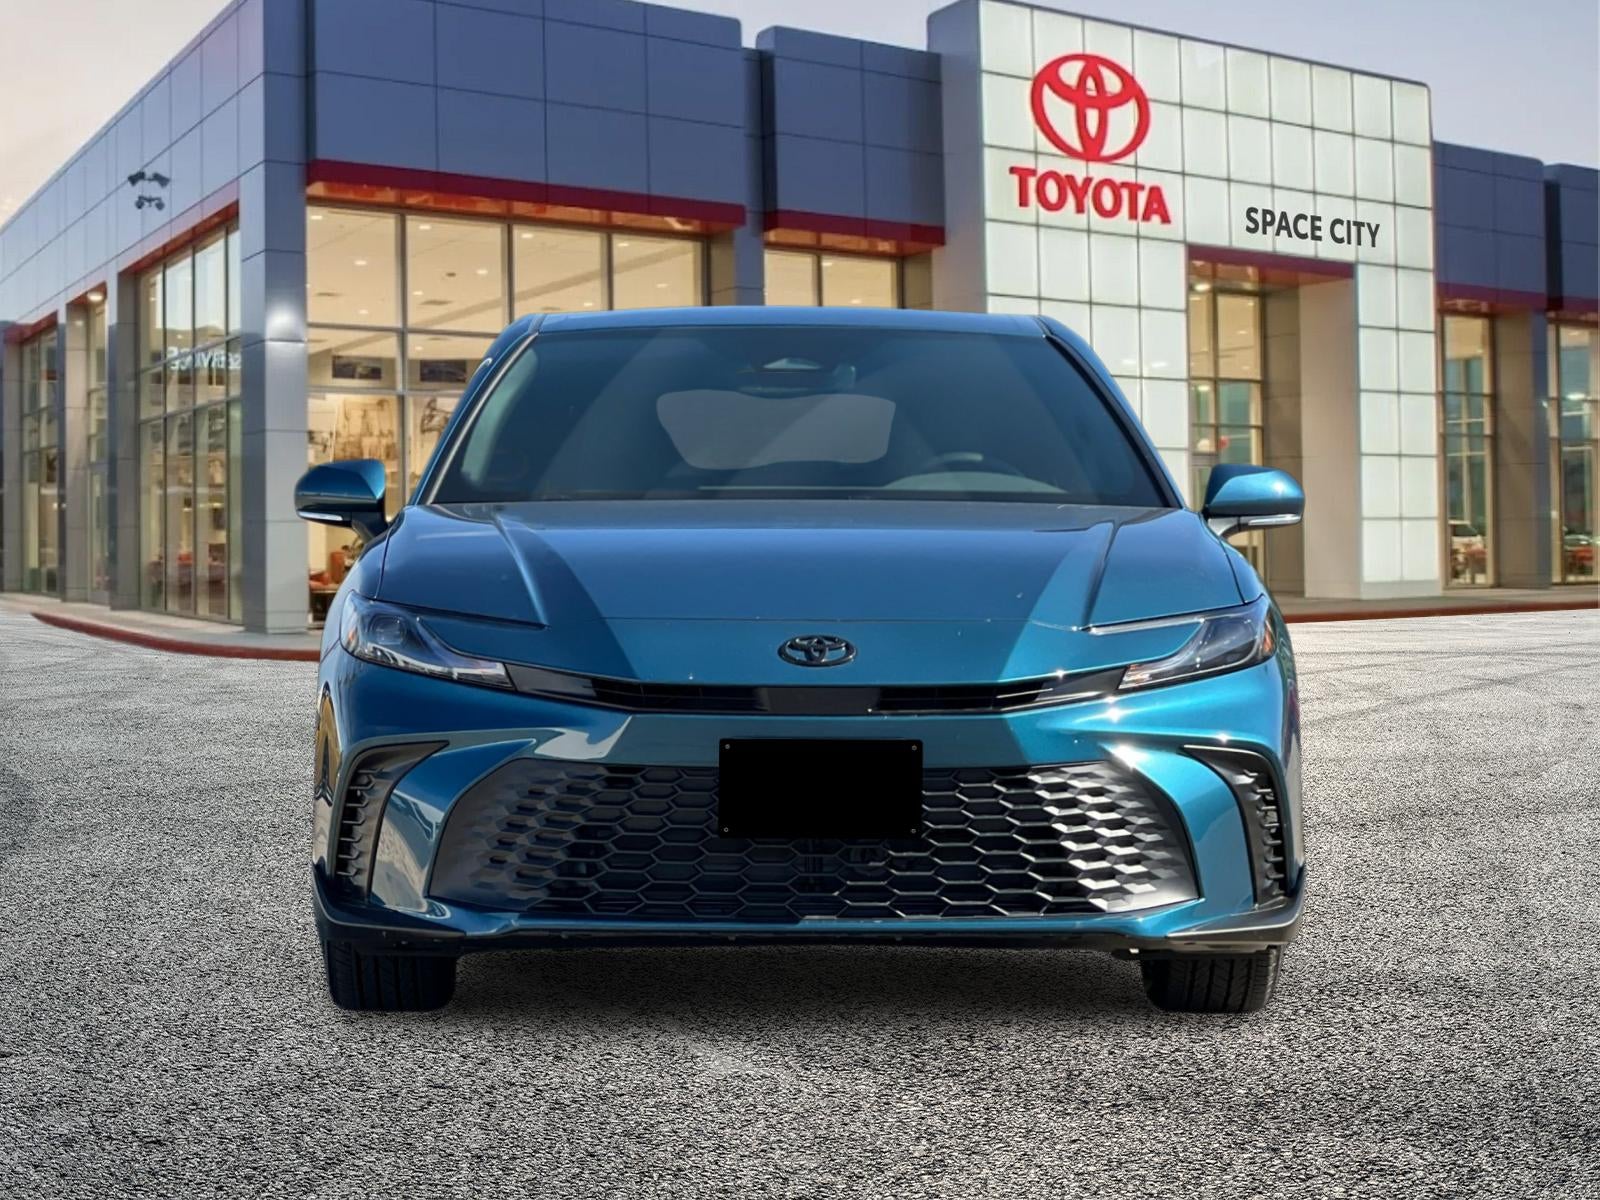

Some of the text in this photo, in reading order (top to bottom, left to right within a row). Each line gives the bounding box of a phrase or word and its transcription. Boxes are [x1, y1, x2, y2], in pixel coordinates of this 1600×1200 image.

[1009, 166, 1171, 224] TOYOTA
[1245, 207, 1380, 248] SPACE CITY
